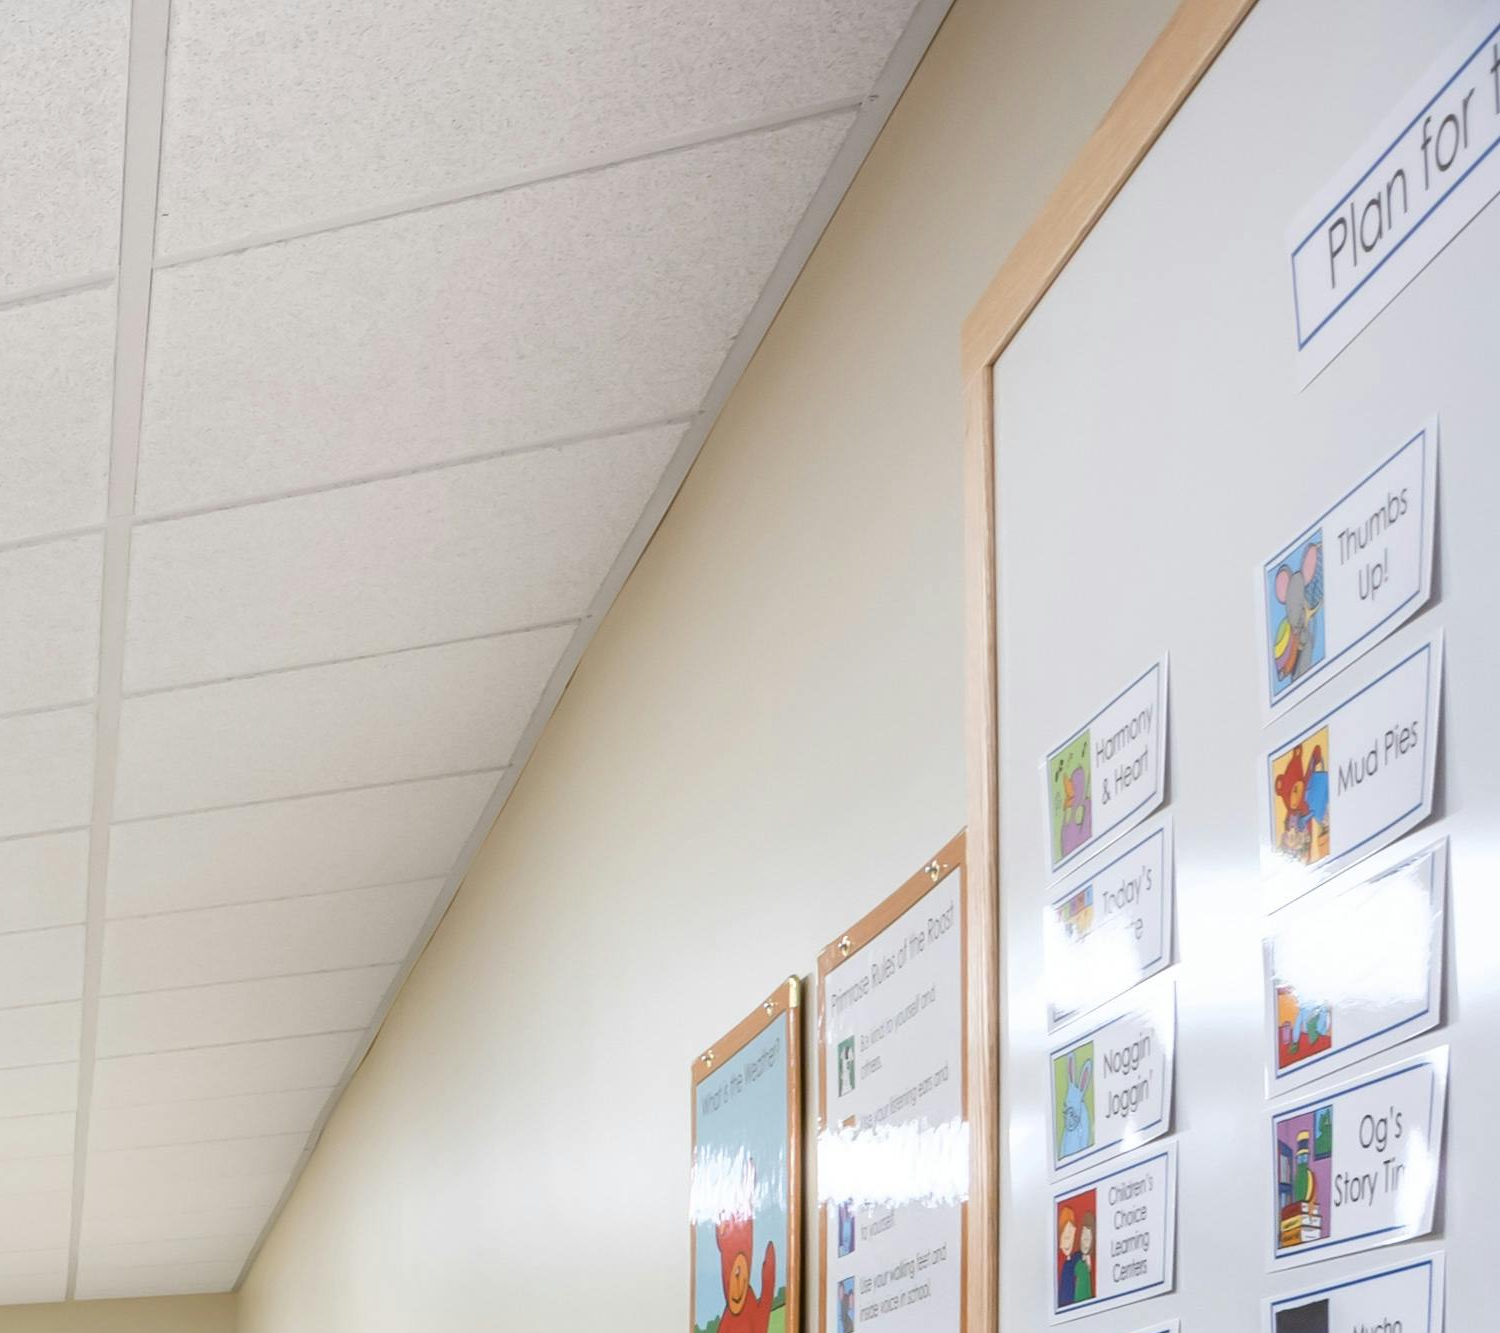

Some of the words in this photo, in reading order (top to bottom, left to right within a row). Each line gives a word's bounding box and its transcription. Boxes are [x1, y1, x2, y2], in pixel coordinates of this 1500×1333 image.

[1327, 167, 1409, 289] Plan
[1419, 85, 1475, 191] for
[1337, 487, 1408, 565] Thumbs
[1358, 548, 1389, 602] Up!
[1095, 704, 1155, 769] Harmony
[1337, 739, 1380, 797] Mud
[1384, 720, 1420, 767] Pies
[1101, 776, 1111, 806] &
[1113, 745, 1149, 790] Heart
[1102, 865, 1153, 914] Today's
[1105, 1069, 1153, 1120] Joggin'
[1358, 1105, 1403, 1154] Og's
[1107, 1173, 1154, 1207] Children's
[1333, 1170, 1379, 1208] Story
[1113, 1206, 1148, 1231] Choice
[1110, 1230, 1150, 1261] Learning
[1112, 1257, 1148, 1284] Centers
